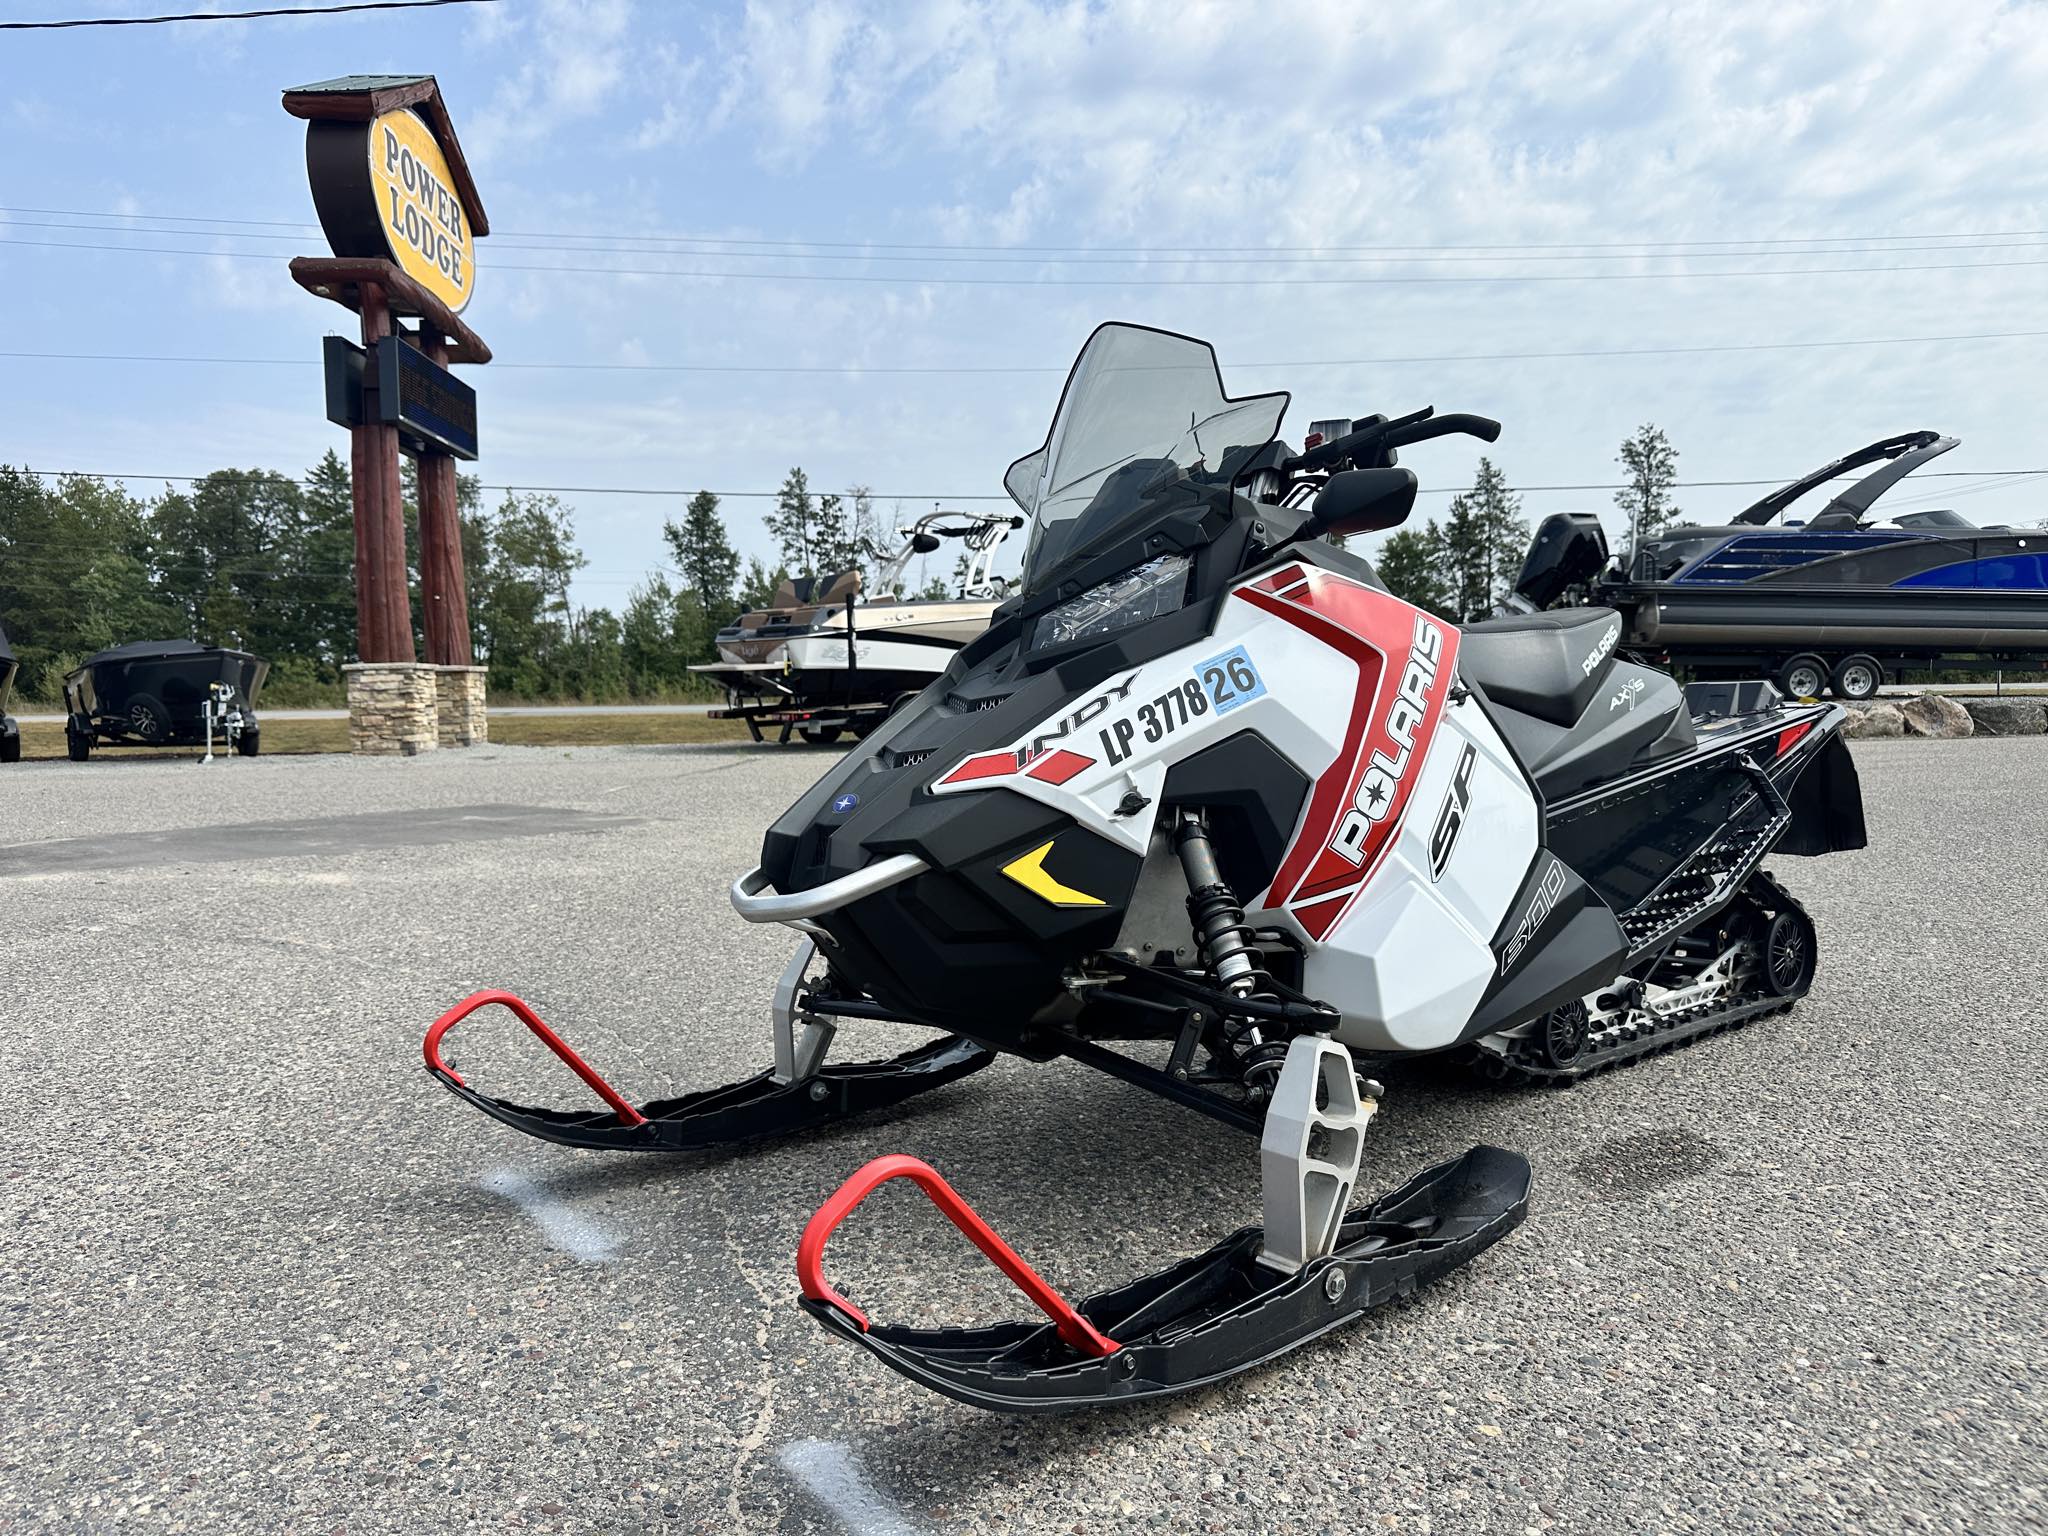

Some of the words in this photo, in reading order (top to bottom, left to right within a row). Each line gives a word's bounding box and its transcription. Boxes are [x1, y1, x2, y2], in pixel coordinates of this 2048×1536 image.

[385, 127, 463, 243] POWER
[391, 186, 463, 289] LODGE
[1203, 656, 1257, 706] 26
[1582, 624, 1619, 677] POLARIS
[1014, 669, 1143, 769] INDY
[1099, 719, 1135, 767] LP
[1136, 678, 1209, 744] 3778
[1330, 614, 1444, 867] POLARIS
[1427, 738, 1481, 884] SP
[1501, 859, 1566, 977] 600
